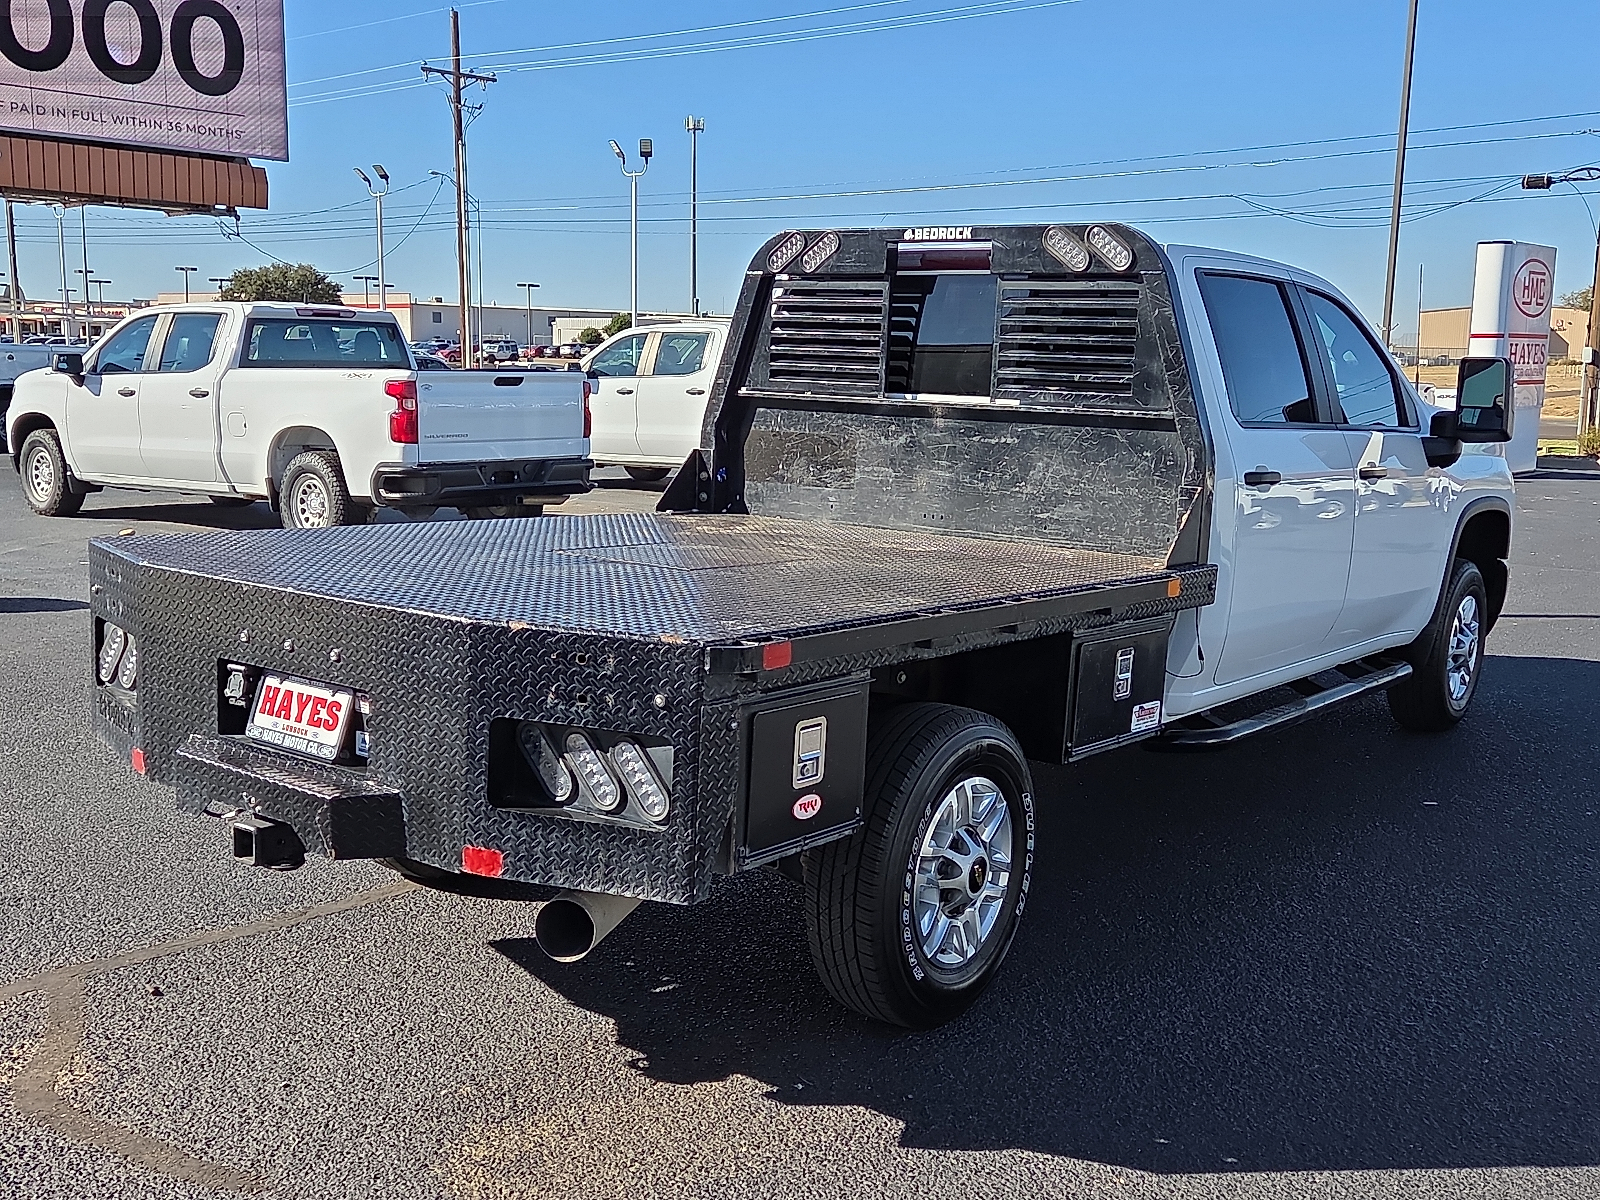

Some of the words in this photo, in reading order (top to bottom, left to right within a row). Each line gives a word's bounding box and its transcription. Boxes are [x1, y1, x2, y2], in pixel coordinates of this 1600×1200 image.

[10, 102, 46, 116] PAID
[52, 107, 67, 118] IN
[72, 110, 107, 124] FULL
[112, 115, 162, 131] WITHIN
[167, 122, 182, 132] 36
[914, 227, 973, 240] BEDROCK
[1509, 343, 1546, 365] HAYES
[259, 685, 342, 731] HAYES
[262, 728, 285, 745] HAYES
[283, 735, 308, 753] MOTOR
[1016, 793, 1035, 916] DUELER
[902, 802, 932, 981] BRIDGESTONE
